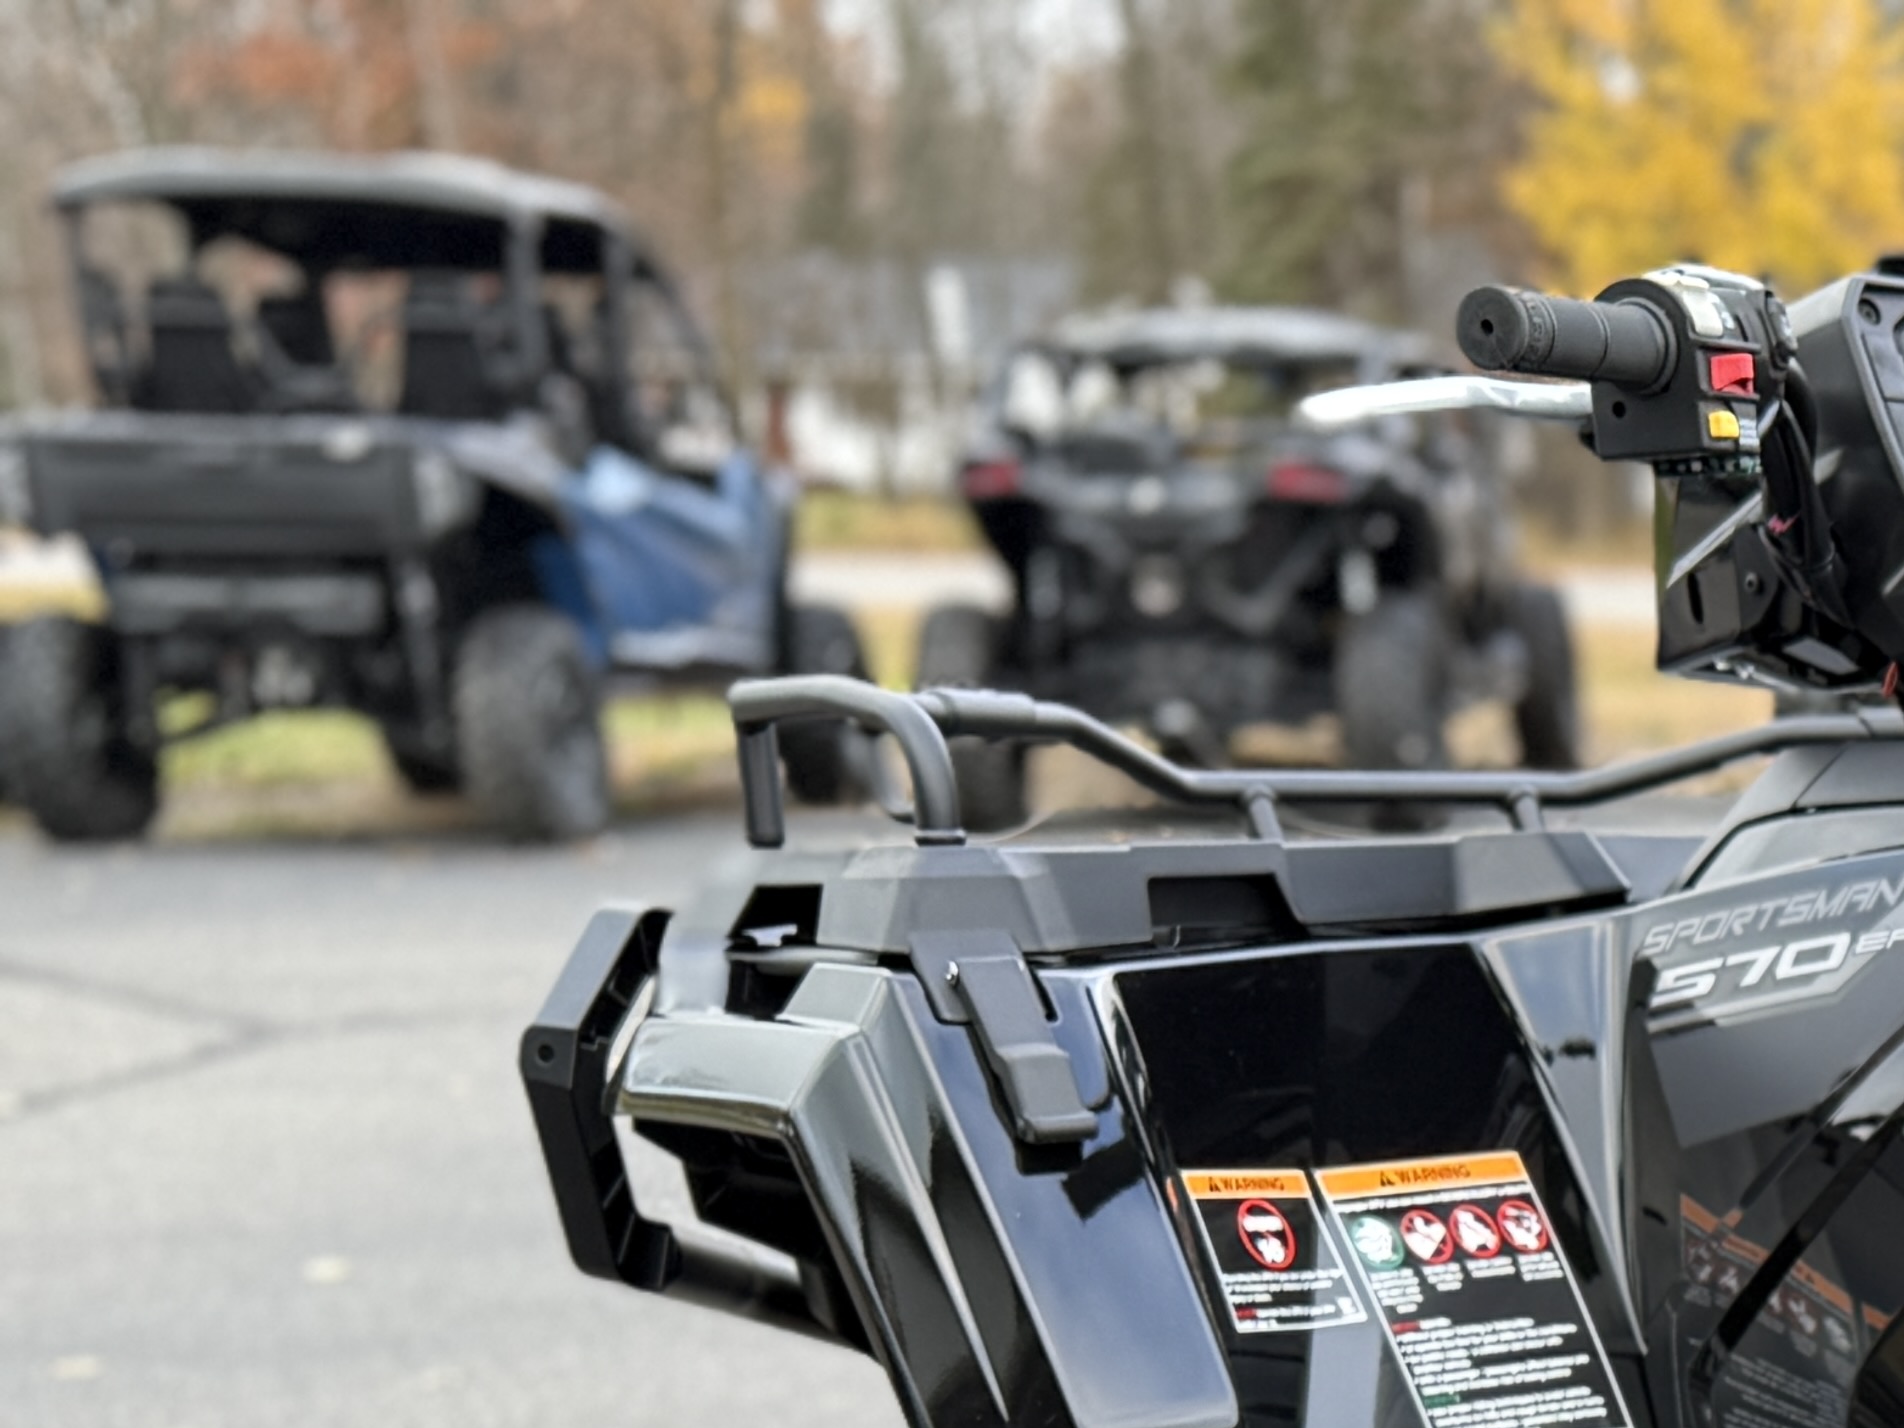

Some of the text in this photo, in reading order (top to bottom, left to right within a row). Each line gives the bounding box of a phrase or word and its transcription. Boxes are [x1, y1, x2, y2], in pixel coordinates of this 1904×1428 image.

[1649, 931, 1854, 1008] 570
[1222, 1176, 1286, 1193] WARNING
[1397, 1162, 1472, 1185] WARNING
